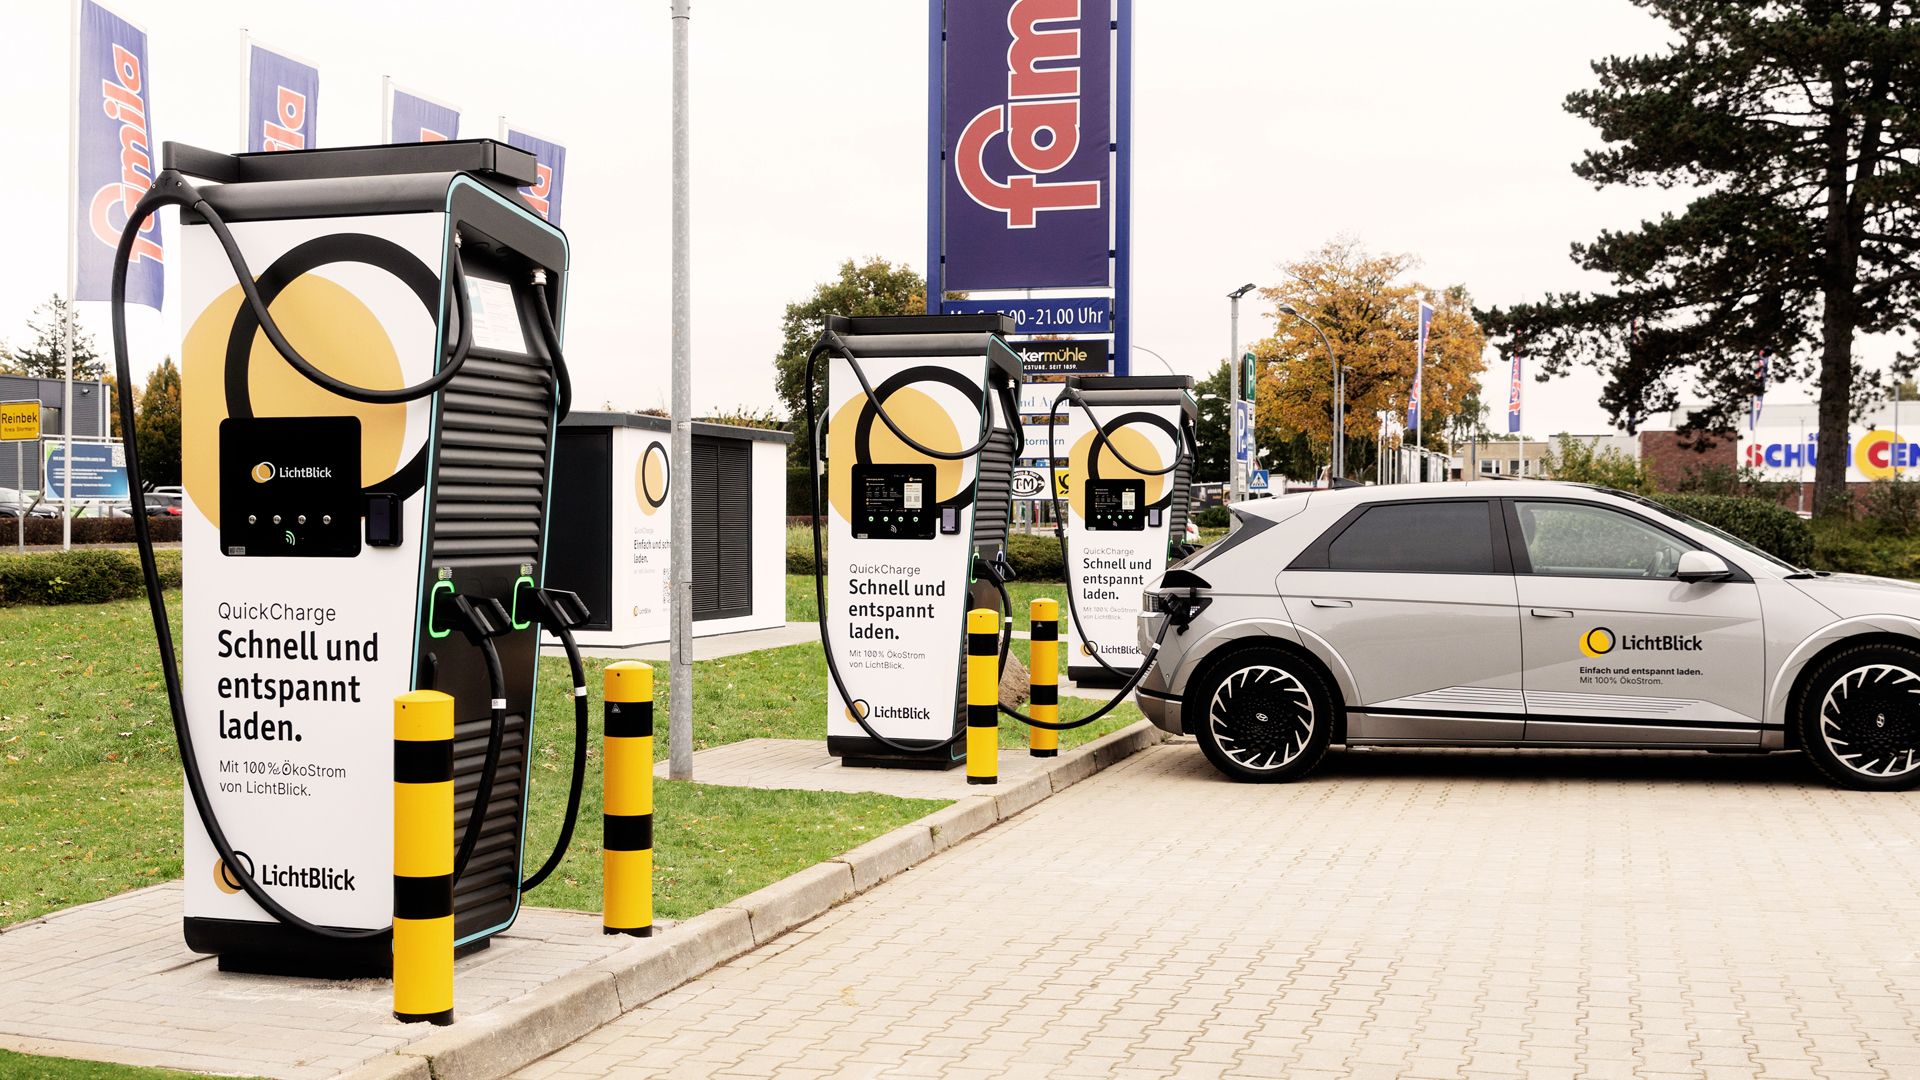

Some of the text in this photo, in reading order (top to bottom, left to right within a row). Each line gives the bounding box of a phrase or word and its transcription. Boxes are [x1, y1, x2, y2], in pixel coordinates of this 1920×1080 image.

[89, 42, 165, 264] famila
[1078, 307, 1104, 324] Uhr
[1, 412, 38, 424] Reinbek
[279, 466, 332, 478] LichtBlick
[1083, 547, 1135, 557] QuickCharge
[849, 563, 921, 577] QuickCharge
[1083, 557, 1152, 570] Schnell und
[849, 578, 946, 597] Schnell und
[1083, 573, 1144, 588] entspannt
[1083, 588, 1119, 600] laden.
[218, 601, 336, 626] QuickCharge
[848, 602, 935, 622] entspannt
[849, 622, 900, 640] laden.
[217, 629, 379, 663] Schnell und
[1100, 644, 1141, 655] LichtBlick
[1622, 634, 1703, 651] LichtBlick
[849, 650, 862, 658] Mit
[886, 649, 926, 660] ÖkoStrom
[849, 661, 905, 671] von LichtBlick.
[1579, 667, 1703, 677] Einfach und entspannt laden.
[1579, 676, 1593, 684] Mit
[1620, 676, 1663, 685] ÖkoStrom.
[217, 672, 361, 708] entspannt
[874, 705, 931, 720] LichtBlick
[219, 709, 303, 742] laden.
[219, 759, 239, 774] Mit
[281, 759, 346, 778] ÖkoStrom
[219, 780, 311, 797] von LichtBlick.
[261, 864, 355, 891] LichtBlick
